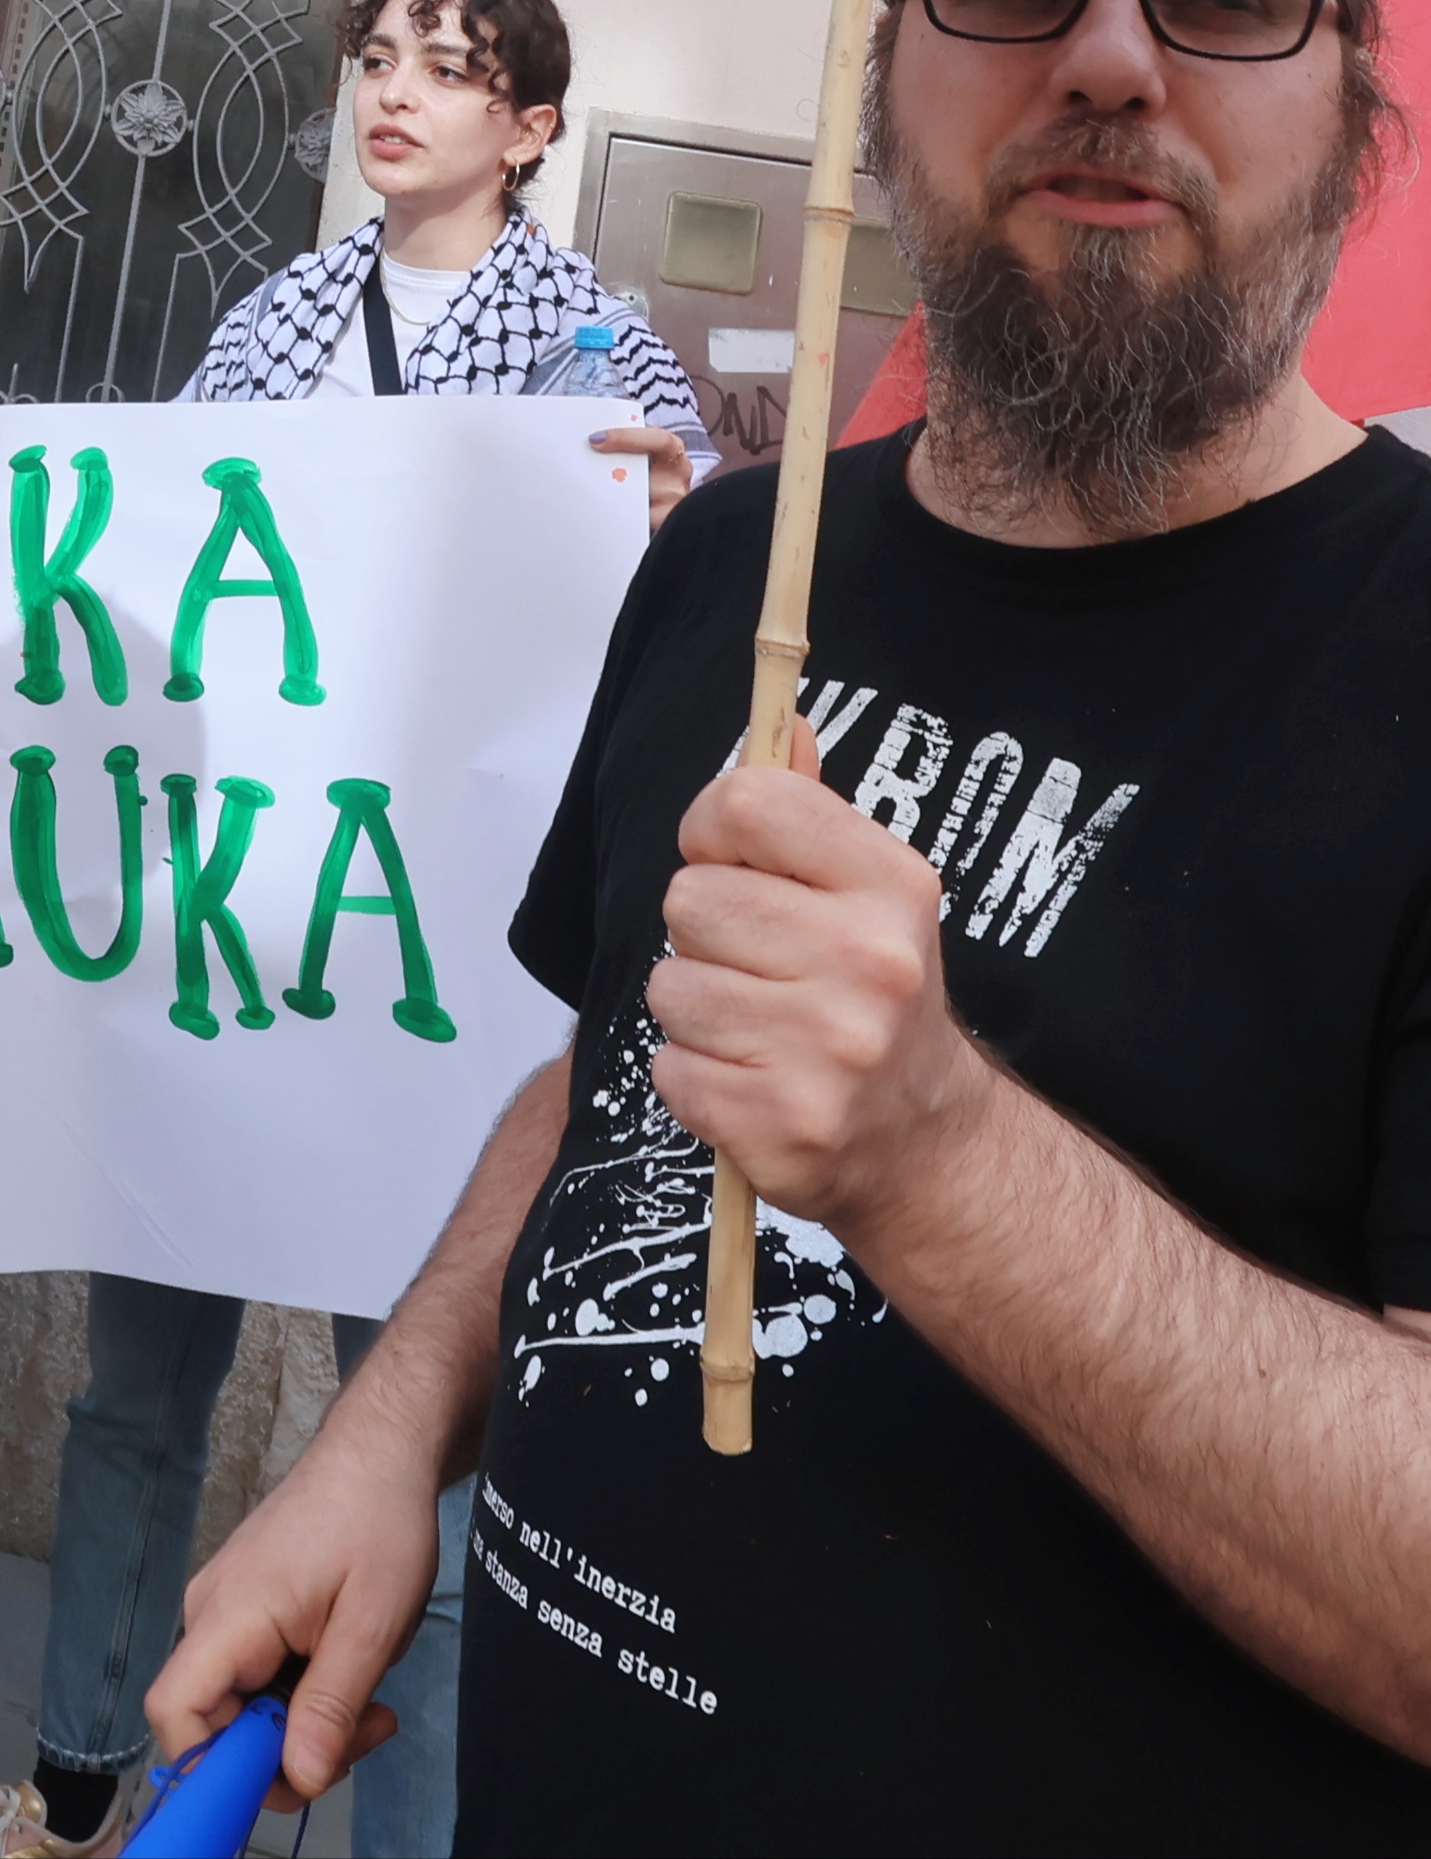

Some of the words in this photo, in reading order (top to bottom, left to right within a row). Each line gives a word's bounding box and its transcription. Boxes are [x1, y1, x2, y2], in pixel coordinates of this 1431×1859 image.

[484, 1549, 529, 1610] stanza
[536, 1598, 603, 1659] senza
[617, 1647, 718, 1715] stelle
[519, 1520, 677, 1634] nell'inerzia
